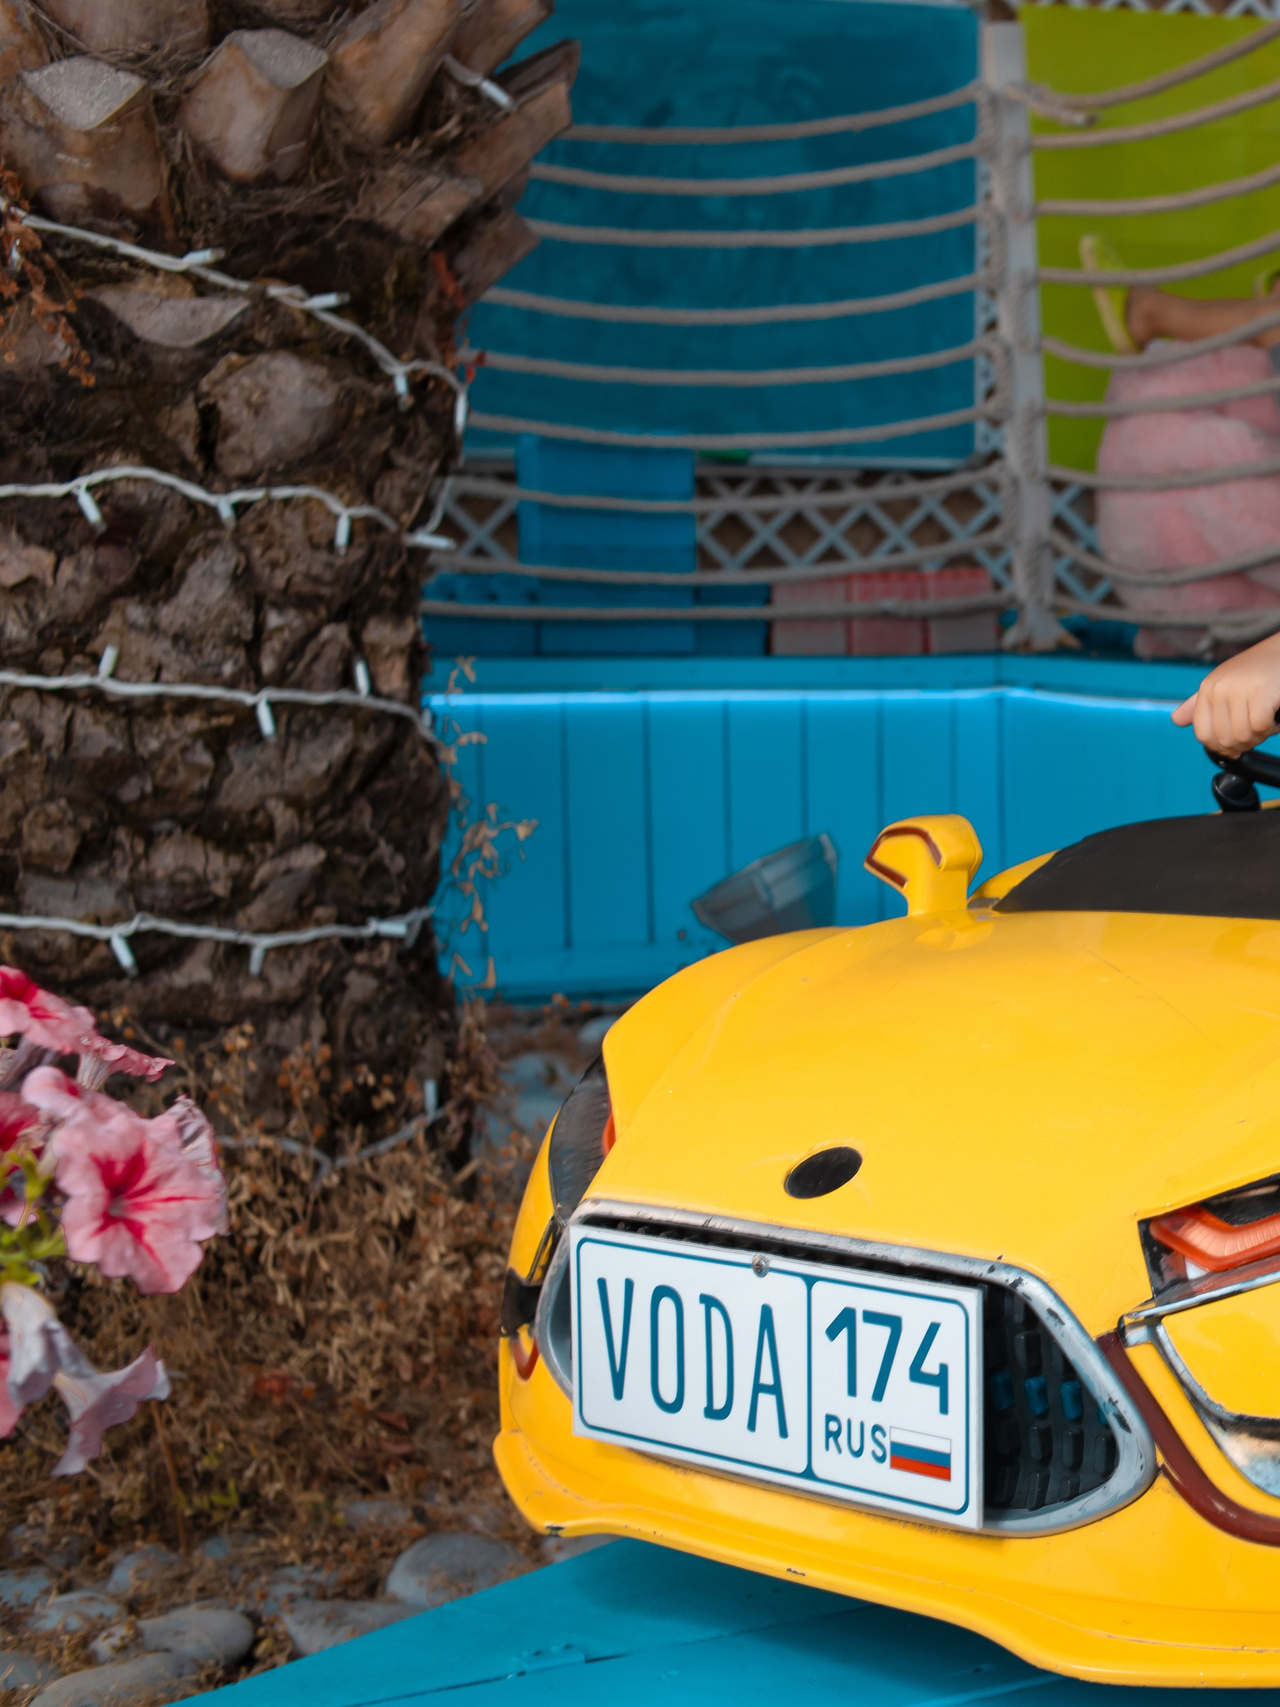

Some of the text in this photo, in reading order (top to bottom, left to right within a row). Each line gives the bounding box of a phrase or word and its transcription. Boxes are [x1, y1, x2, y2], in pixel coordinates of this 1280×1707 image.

[597, 1277, 949, 1439] VODA 174
[824, 1413, 888, 1464] RUS
